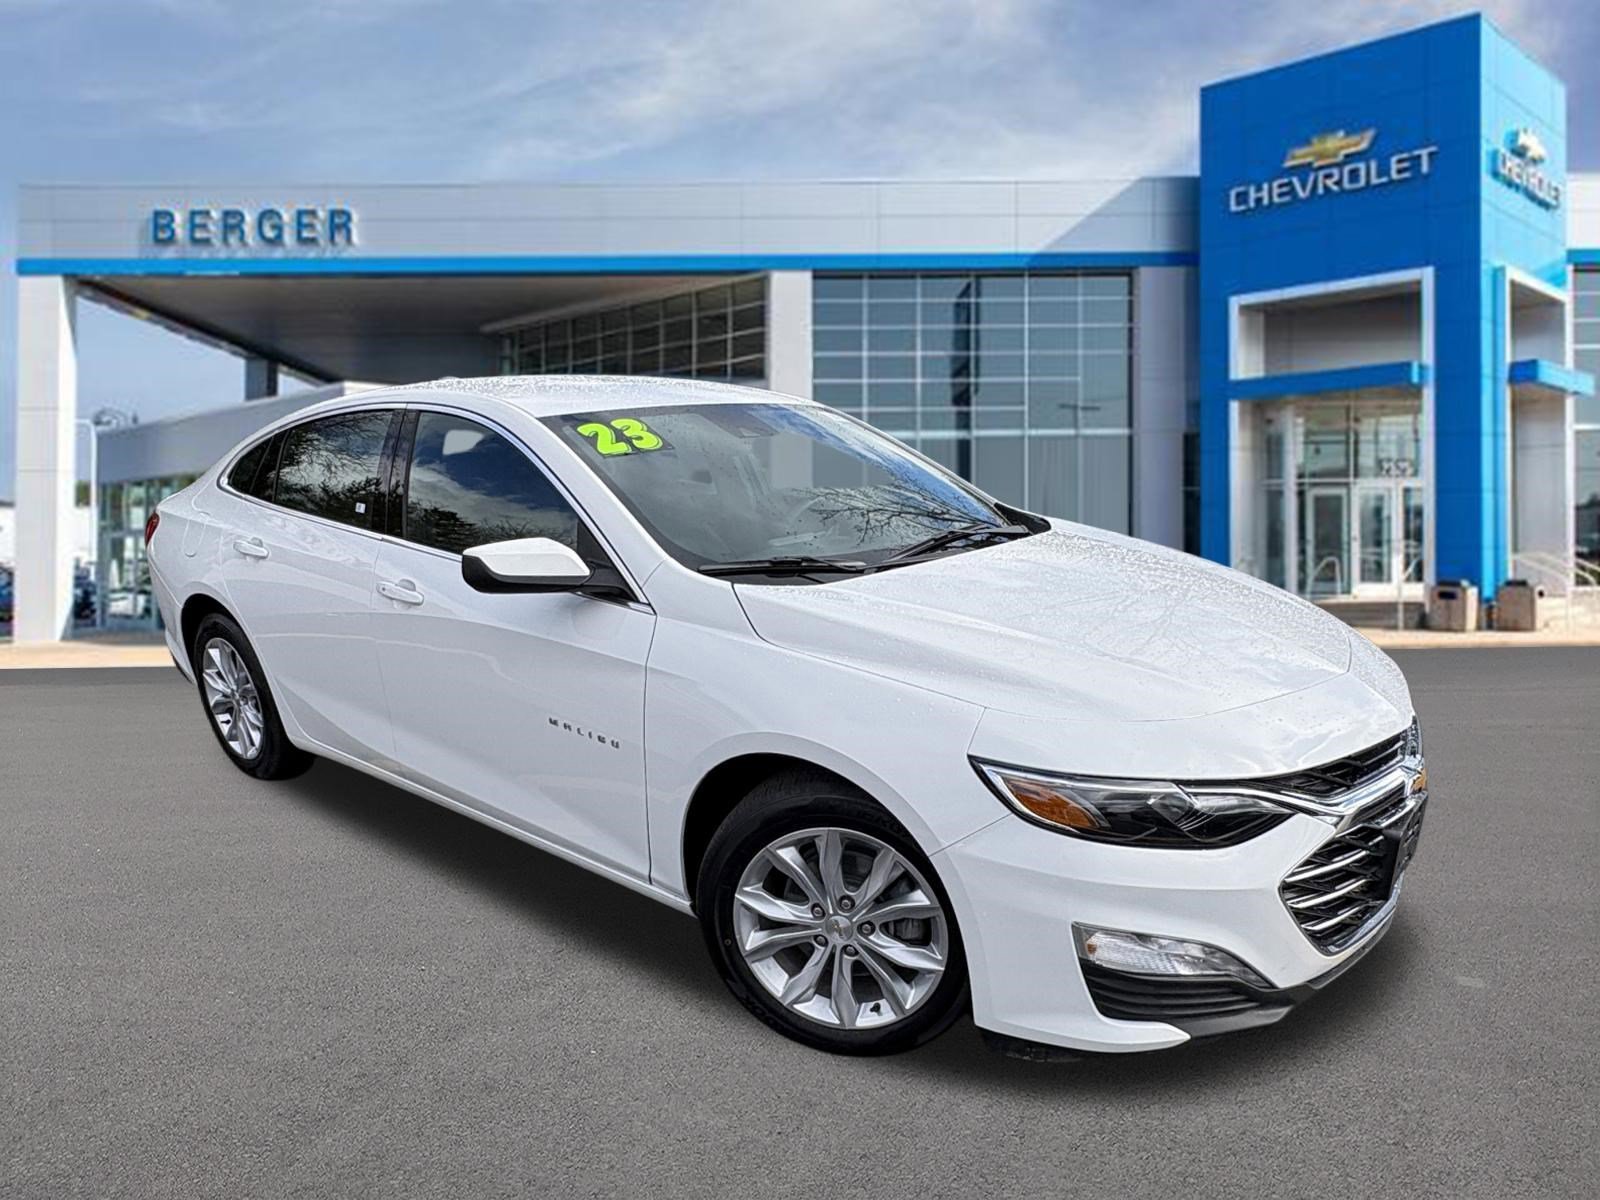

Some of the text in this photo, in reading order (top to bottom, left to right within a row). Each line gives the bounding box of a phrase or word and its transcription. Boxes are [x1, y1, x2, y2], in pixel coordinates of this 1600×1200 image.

[1228, 145, 1438, 212] CHEVROLET
[152, 208, 355, 246] BERGER
[576, 417, 662, 455] 23
